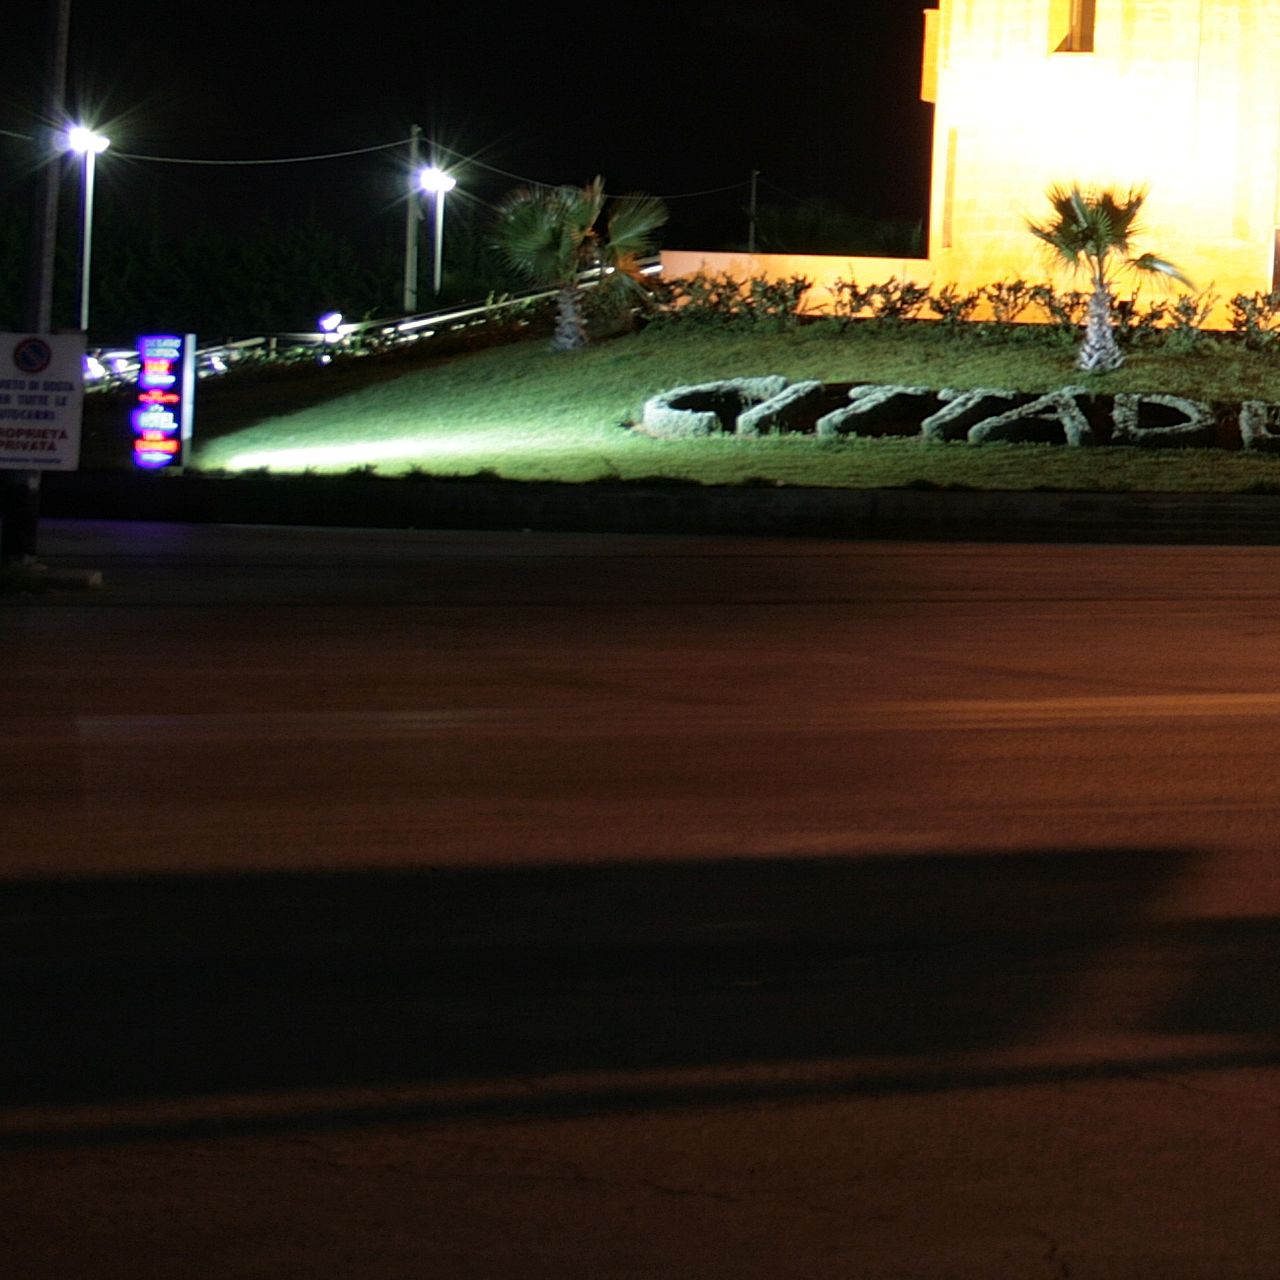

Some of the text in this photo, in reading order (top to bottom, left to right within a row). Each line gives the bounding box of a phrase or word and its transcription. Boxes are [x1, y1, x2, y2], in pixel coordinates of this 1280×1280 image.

[42, 381, 75, 391] SOSTA
[17, 394, 48, 406] TUTTE
[55, 395, 68, 407] LE
